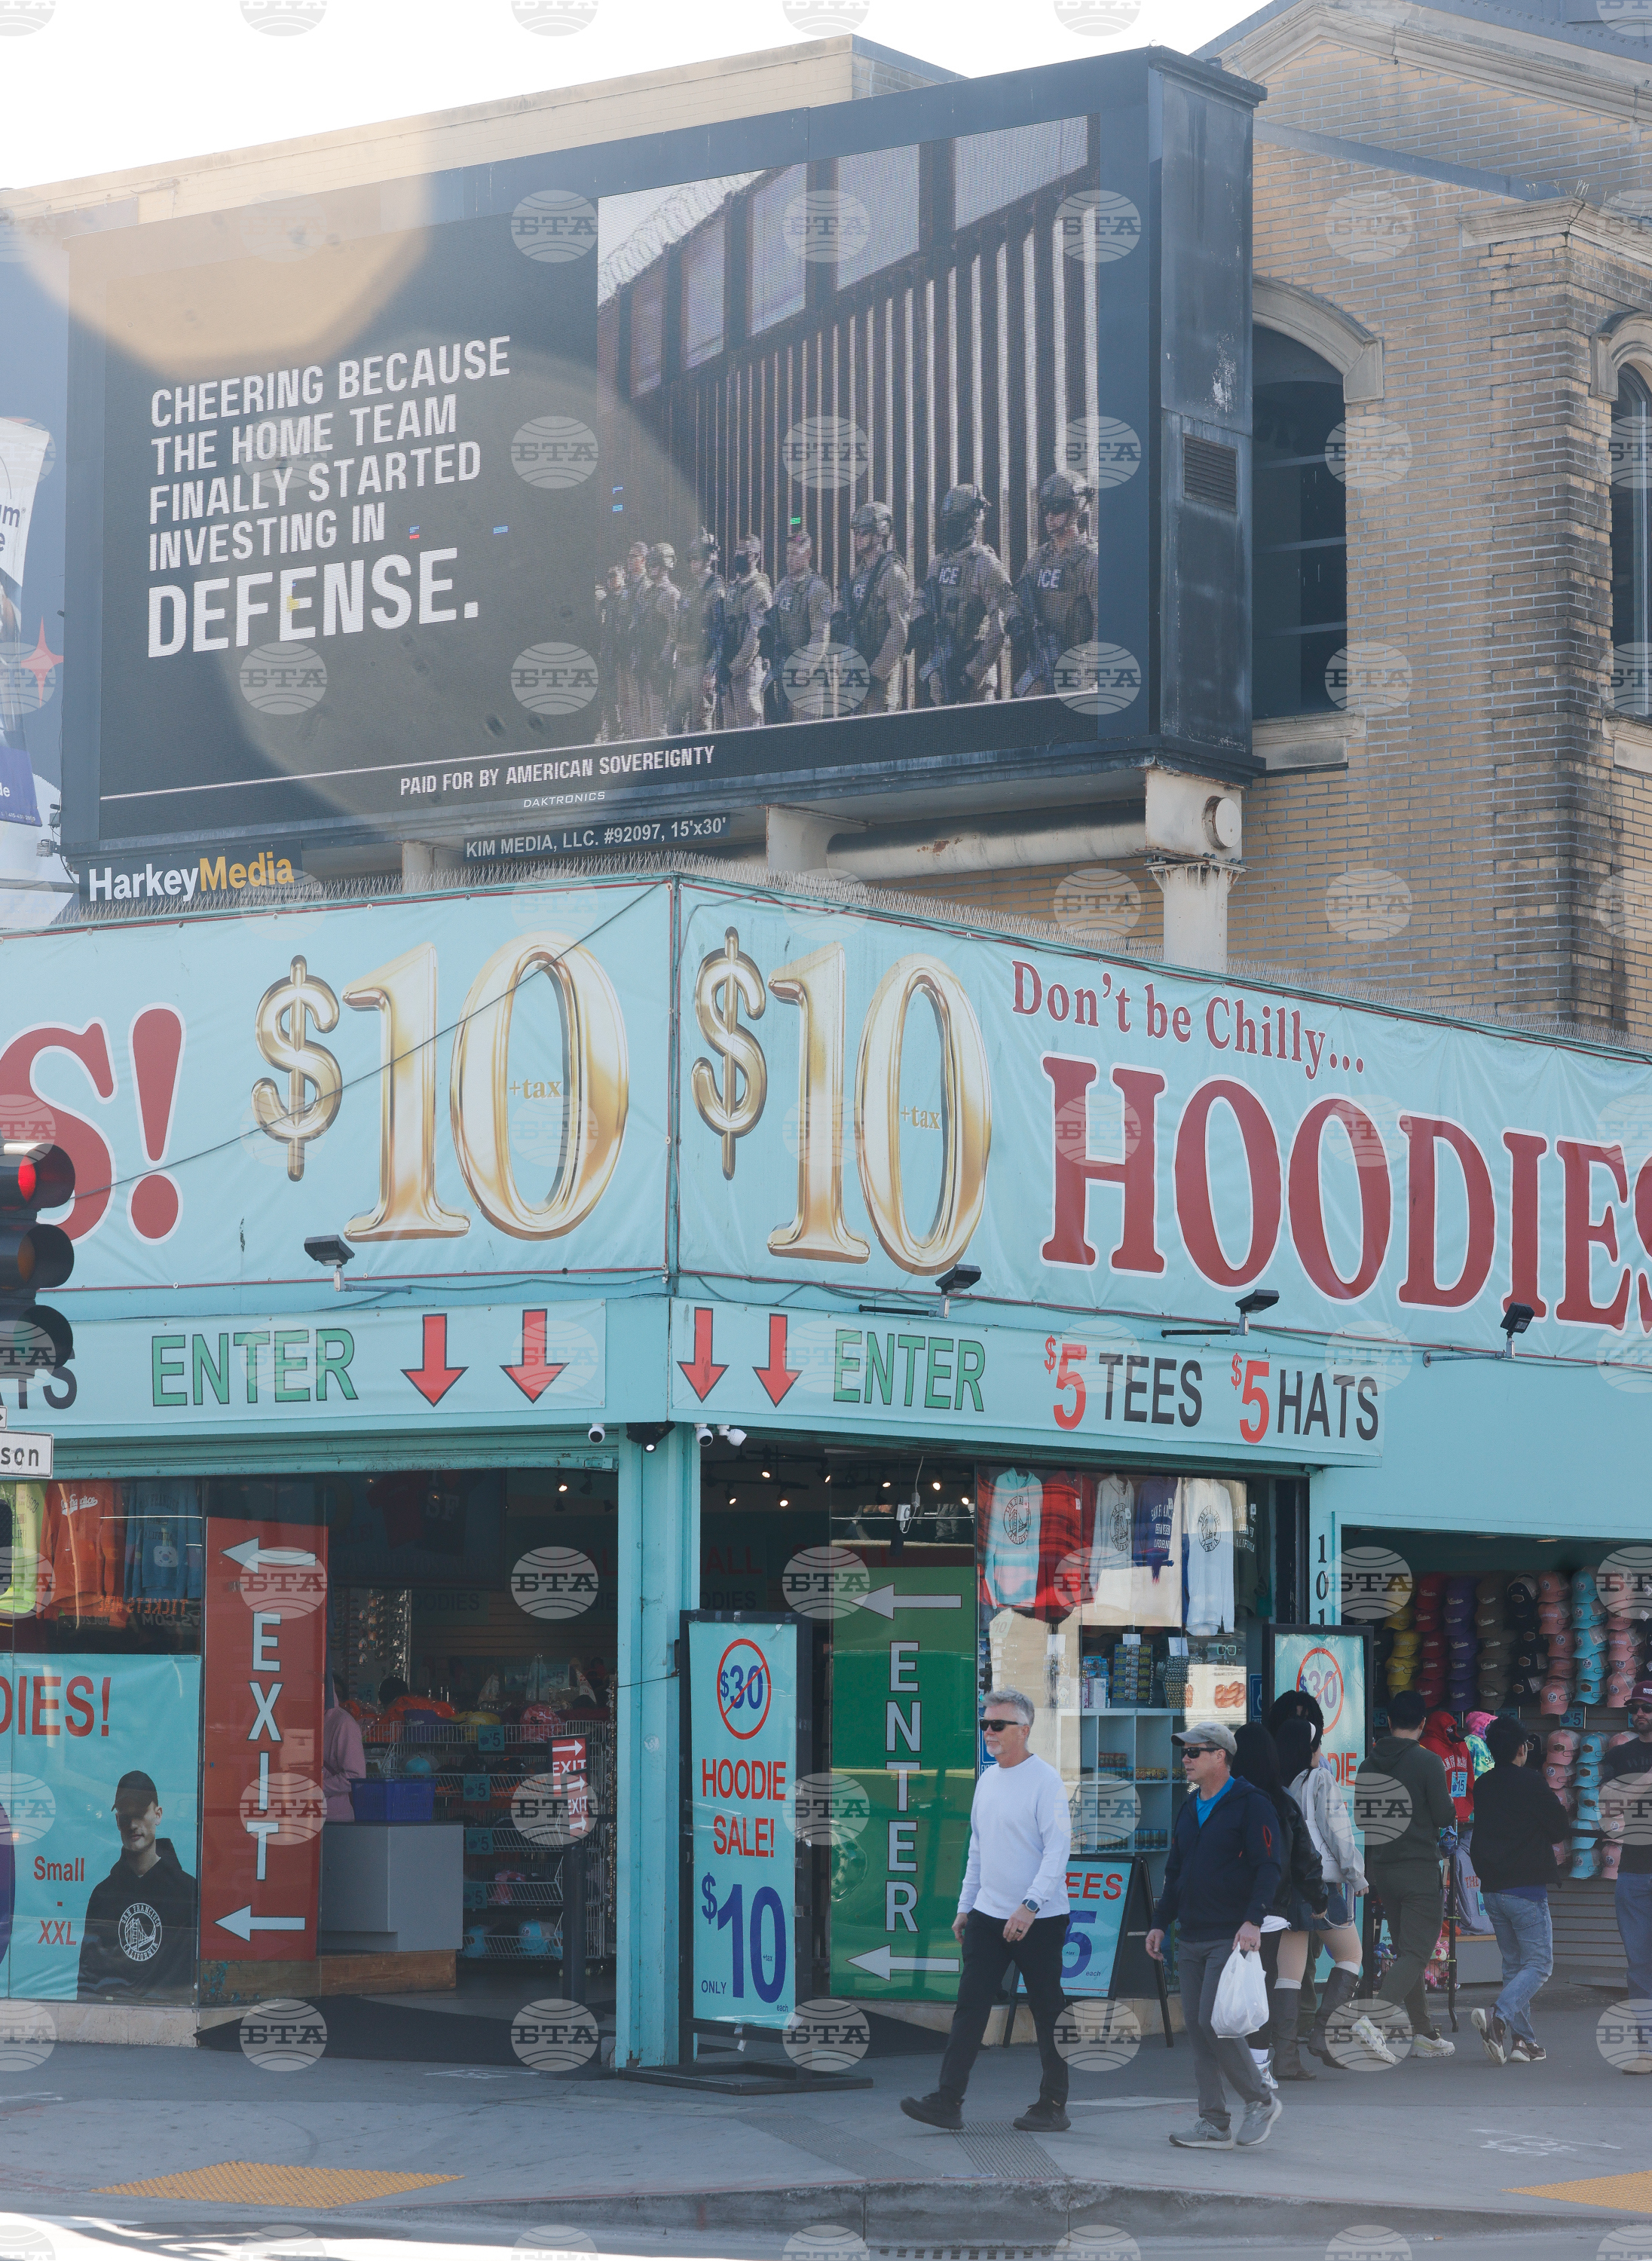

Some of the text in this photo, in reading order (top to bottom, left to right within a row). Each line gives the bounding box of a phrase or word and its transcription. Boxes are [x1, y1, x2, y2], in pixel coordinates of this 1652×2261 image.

[151, 335, 511, 427] CHEERING BECAUSE
[151, 393, 457, 476] THE HOME TEAM
[149, 440, 481, 525] FINALLY STARTED
[148, 501, 386, 571] INVESTING IN
[939, 566, 959, 586] ICE
[1038, 568, 1061, 589] ICE
[148, 546, 479, 658] DEFENSE.
[400, 745, 714, 796] PAID FOR BY AMERICAN SOVEREIGNTY
[523, 791, 606, 809] DAKTRONICS
[466, 817, 727, 858] KIM MEDIA, LLC. #92097, 15'x30'
[89, 852, 295, 902] HarkeyMedia
[1145, 982, 1192, 1043] be
[1205, 996, 1364, 1080] Chilly...
[251, 932, 630, 1243] $10
[508, 1077, 563, 1100] +tax
[691, 927, 993, 1277] $10
[900, 1104, 943, 1130] +tax
[1041, 1054, 1652, 1331] HOODIE
[152, 1328, 359, 1408] ENTER
[833, 1329, 985, 1412] ENTER
[1045, 1335, 1380, 1444] $5 TEES $5 HATS
[0, 1446, 39, 1467] son
[700, 1545, 763, 1575] ALL
[720, 1664, 763, 1710] $30
[246, 1611, 284, 1881] EXIT
[552, 1759, 586, 1776] EXIT
[702, 1758, 786, 1801] HOODIE
[885, 1640, 922, 1934] ENTER
[1323, 1752, 1357, 1787] DIE
[567, 1795, 588, 1816] EXIT
[713, 1815, 775, 1858] SALE!
[34, 1856, 84, 1882] Small
[1065, 1872, 1123, 1900] EES
[38, 1920, 77, 1946] XXL
[120, 1905, 161, 1927] SAN FRANCISCO
[701, 1872, 787, 2003] $10
[123, 1942, 159, 1960] CALIFORNIA
[763, 1953, 772, 1962] +tax
[701, 1979, 727, 1995] ONLY
[776, 2003, 789, 2013] each
